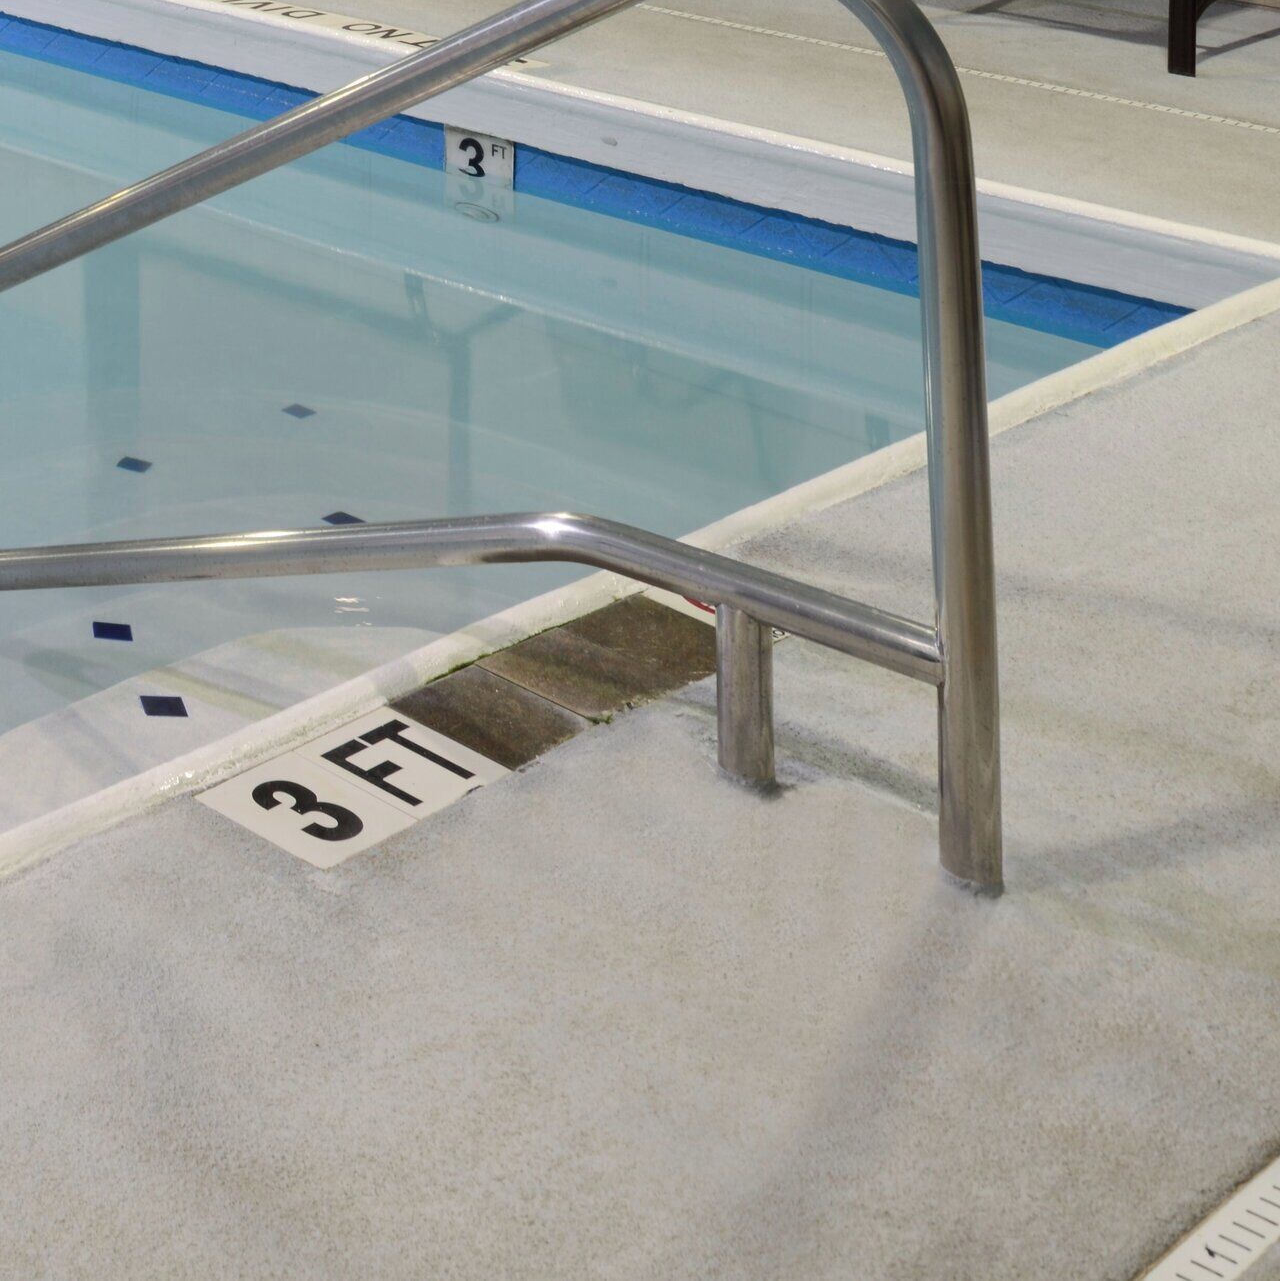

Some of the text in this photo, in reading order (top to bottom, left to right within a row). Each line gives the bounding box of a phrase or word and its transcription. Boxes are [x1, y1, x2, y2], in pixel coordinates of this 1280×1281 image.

[342, 23, 412, 39] NO
[458, 138, 507, 178] 3 FT
[252, 719, 476, 842] 3 FT
